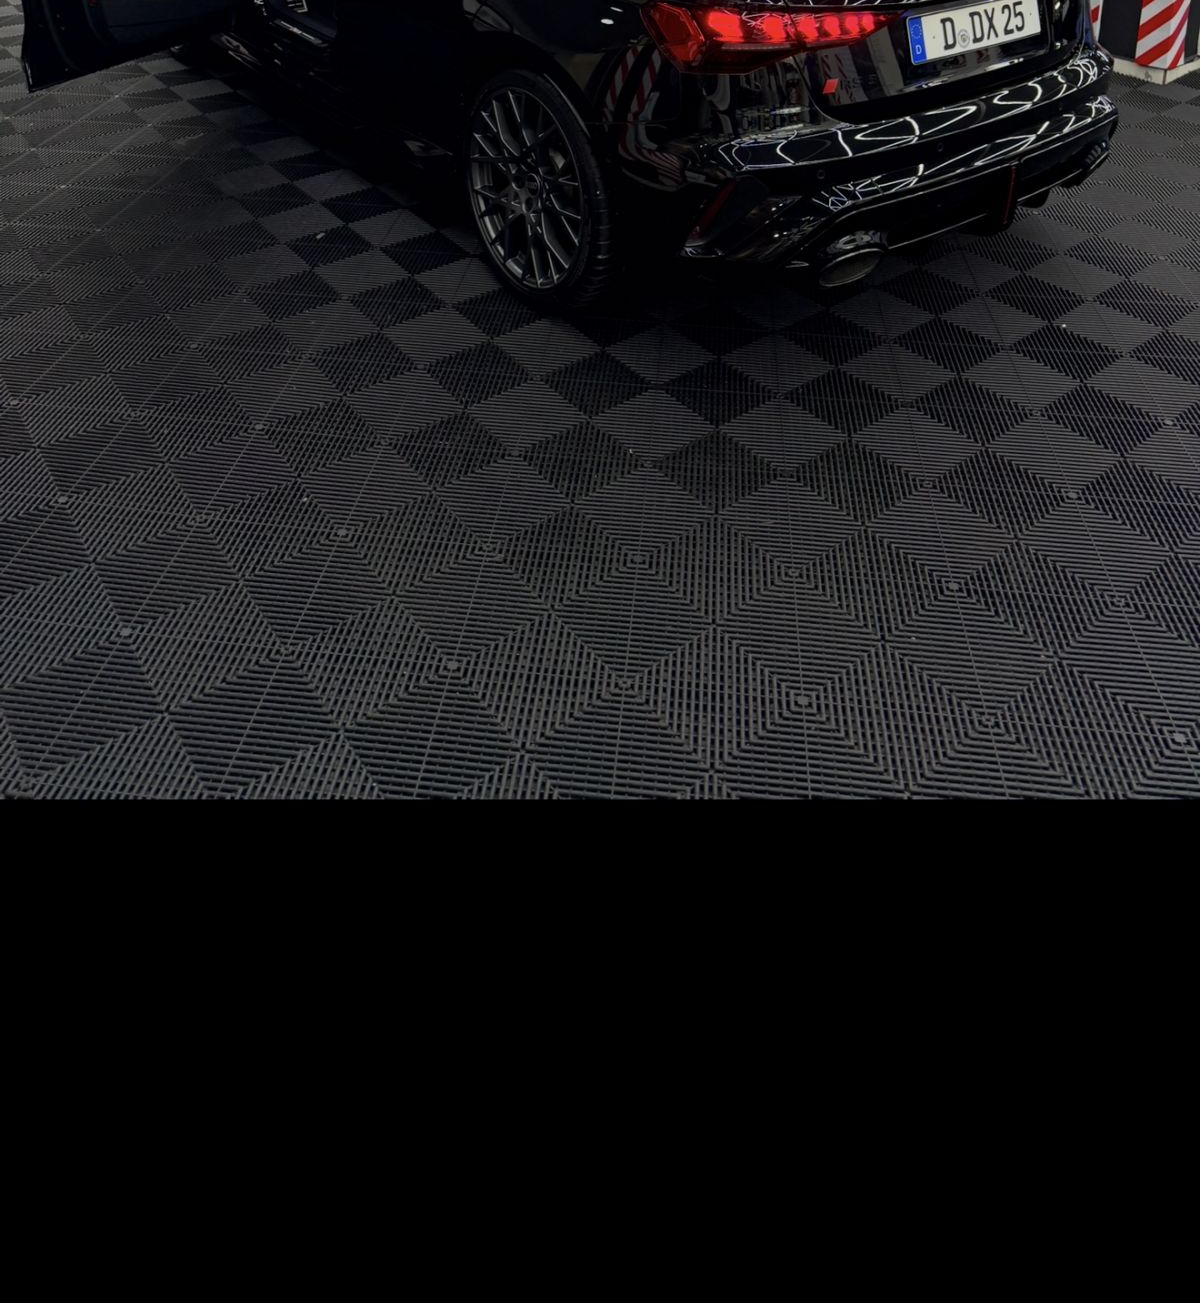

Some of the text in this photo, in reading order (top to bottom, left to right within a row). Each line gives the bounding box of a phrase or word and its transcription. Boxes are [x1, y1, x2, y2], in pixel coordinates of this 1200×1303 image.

[940, 1, 1025, 51] D DX 25
[916, 45, 923, 55] D
